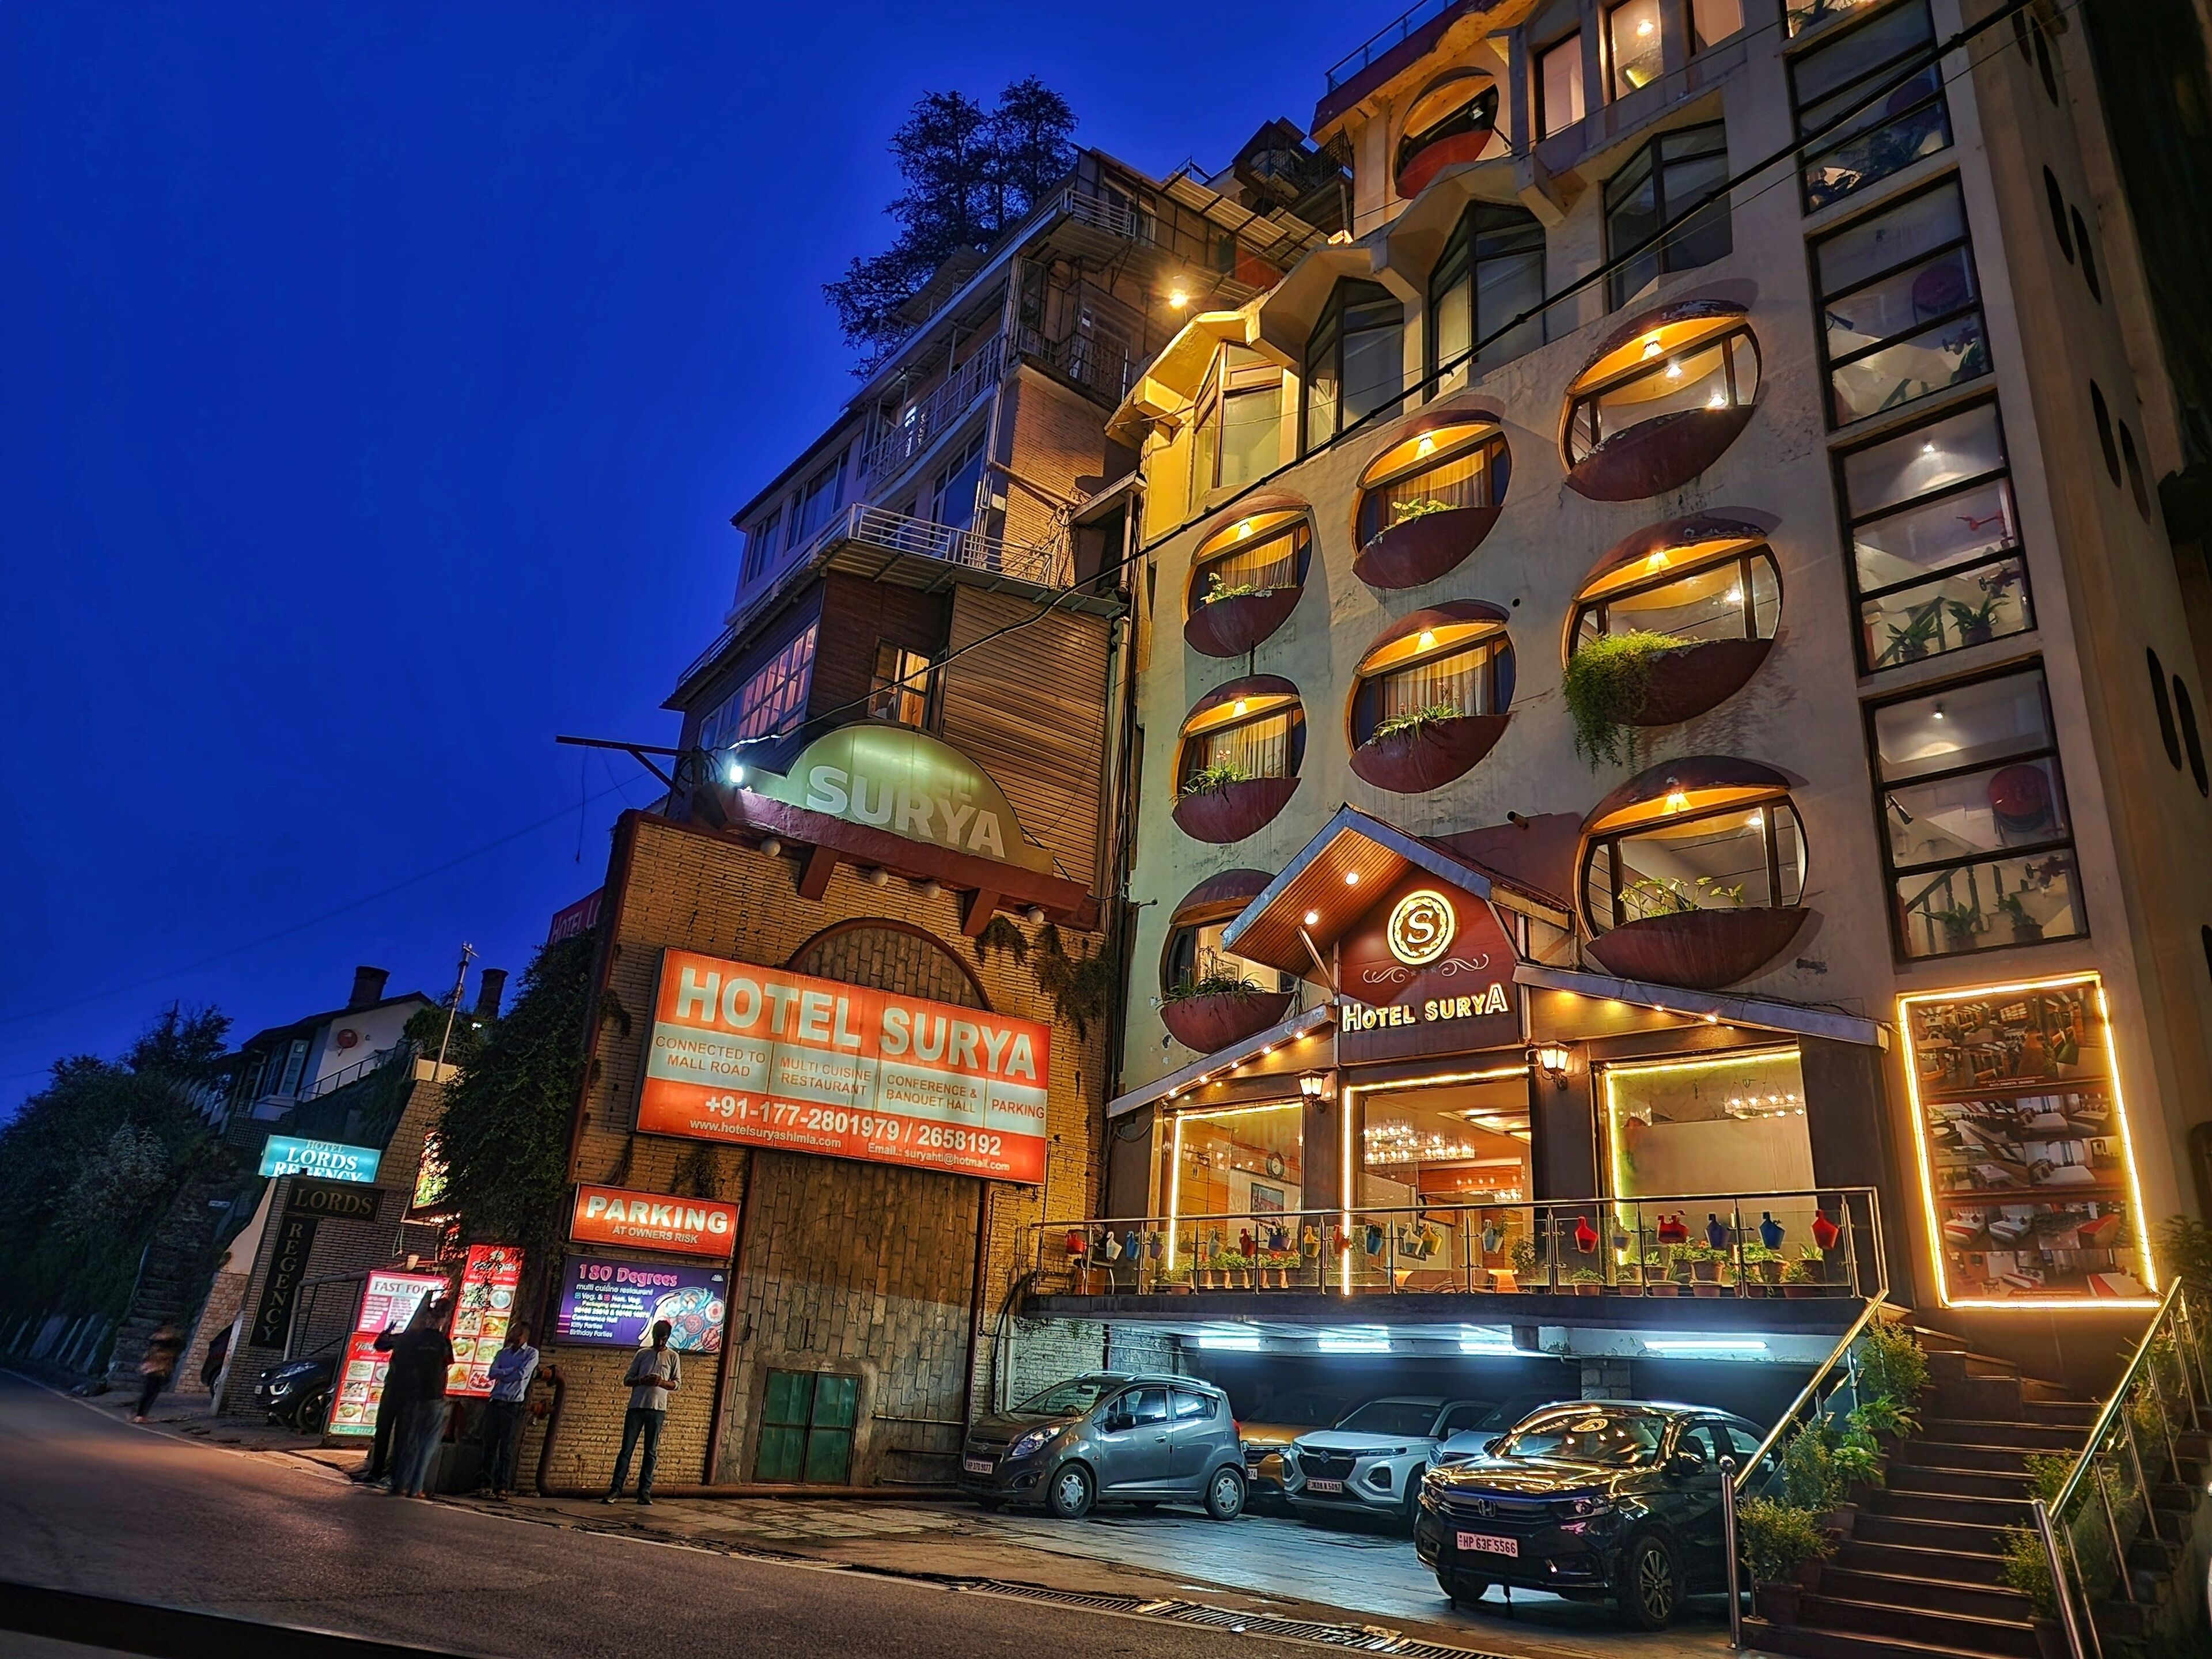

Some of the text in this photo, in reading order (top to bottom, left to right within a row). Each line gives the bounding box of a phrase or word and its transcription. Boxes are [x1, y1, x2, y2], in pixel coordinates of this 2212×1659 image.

[806, 766, 1005, 858] SURYA
[1407, 910, 1434, 943] S
[1342, 983, 1508, 1032] HOTEL SURYA
[675, 967, 1037, 1081] HOTEL SURYA
[655, 1036, 766, 1063] CONNECTED TO
[667, 1054, 750, 1077] MALL ROAD
[780, 1056, 872, 1081] MULTI CUISINE
[781, 1073, 867, 1096] RESTAURANT
[887, 1074, 978, 1099] CONFERENCE &
[887, 1089, 976, 1113] BANQUET HALL
[991, 1099, 1044, 1119] PARKING
[690, 1120, 841, 1147] www.hotelsuryashimla.com
[706, 1095, 899, 1141] +91-177-2801979
[918, 1126, 1001, 1156] 2658192
[286, 1147, 358, 1171] LORDS
[305, 1140, 345, 1153] HOTEL
[294, 1188, 373, 1214] LORDS
[586, 1196, 728, 1233] PARKING
[612, 1226, 698, 1244] AT OWNERS RISK
[262, 1223, 304, 1341] REGENCY
[374, 1281, 403, 1293] FAST
[579, 1264, 678, 1287] 180 Degrees
[1463, 1536, 1516, 1554] HP 63F 5566
